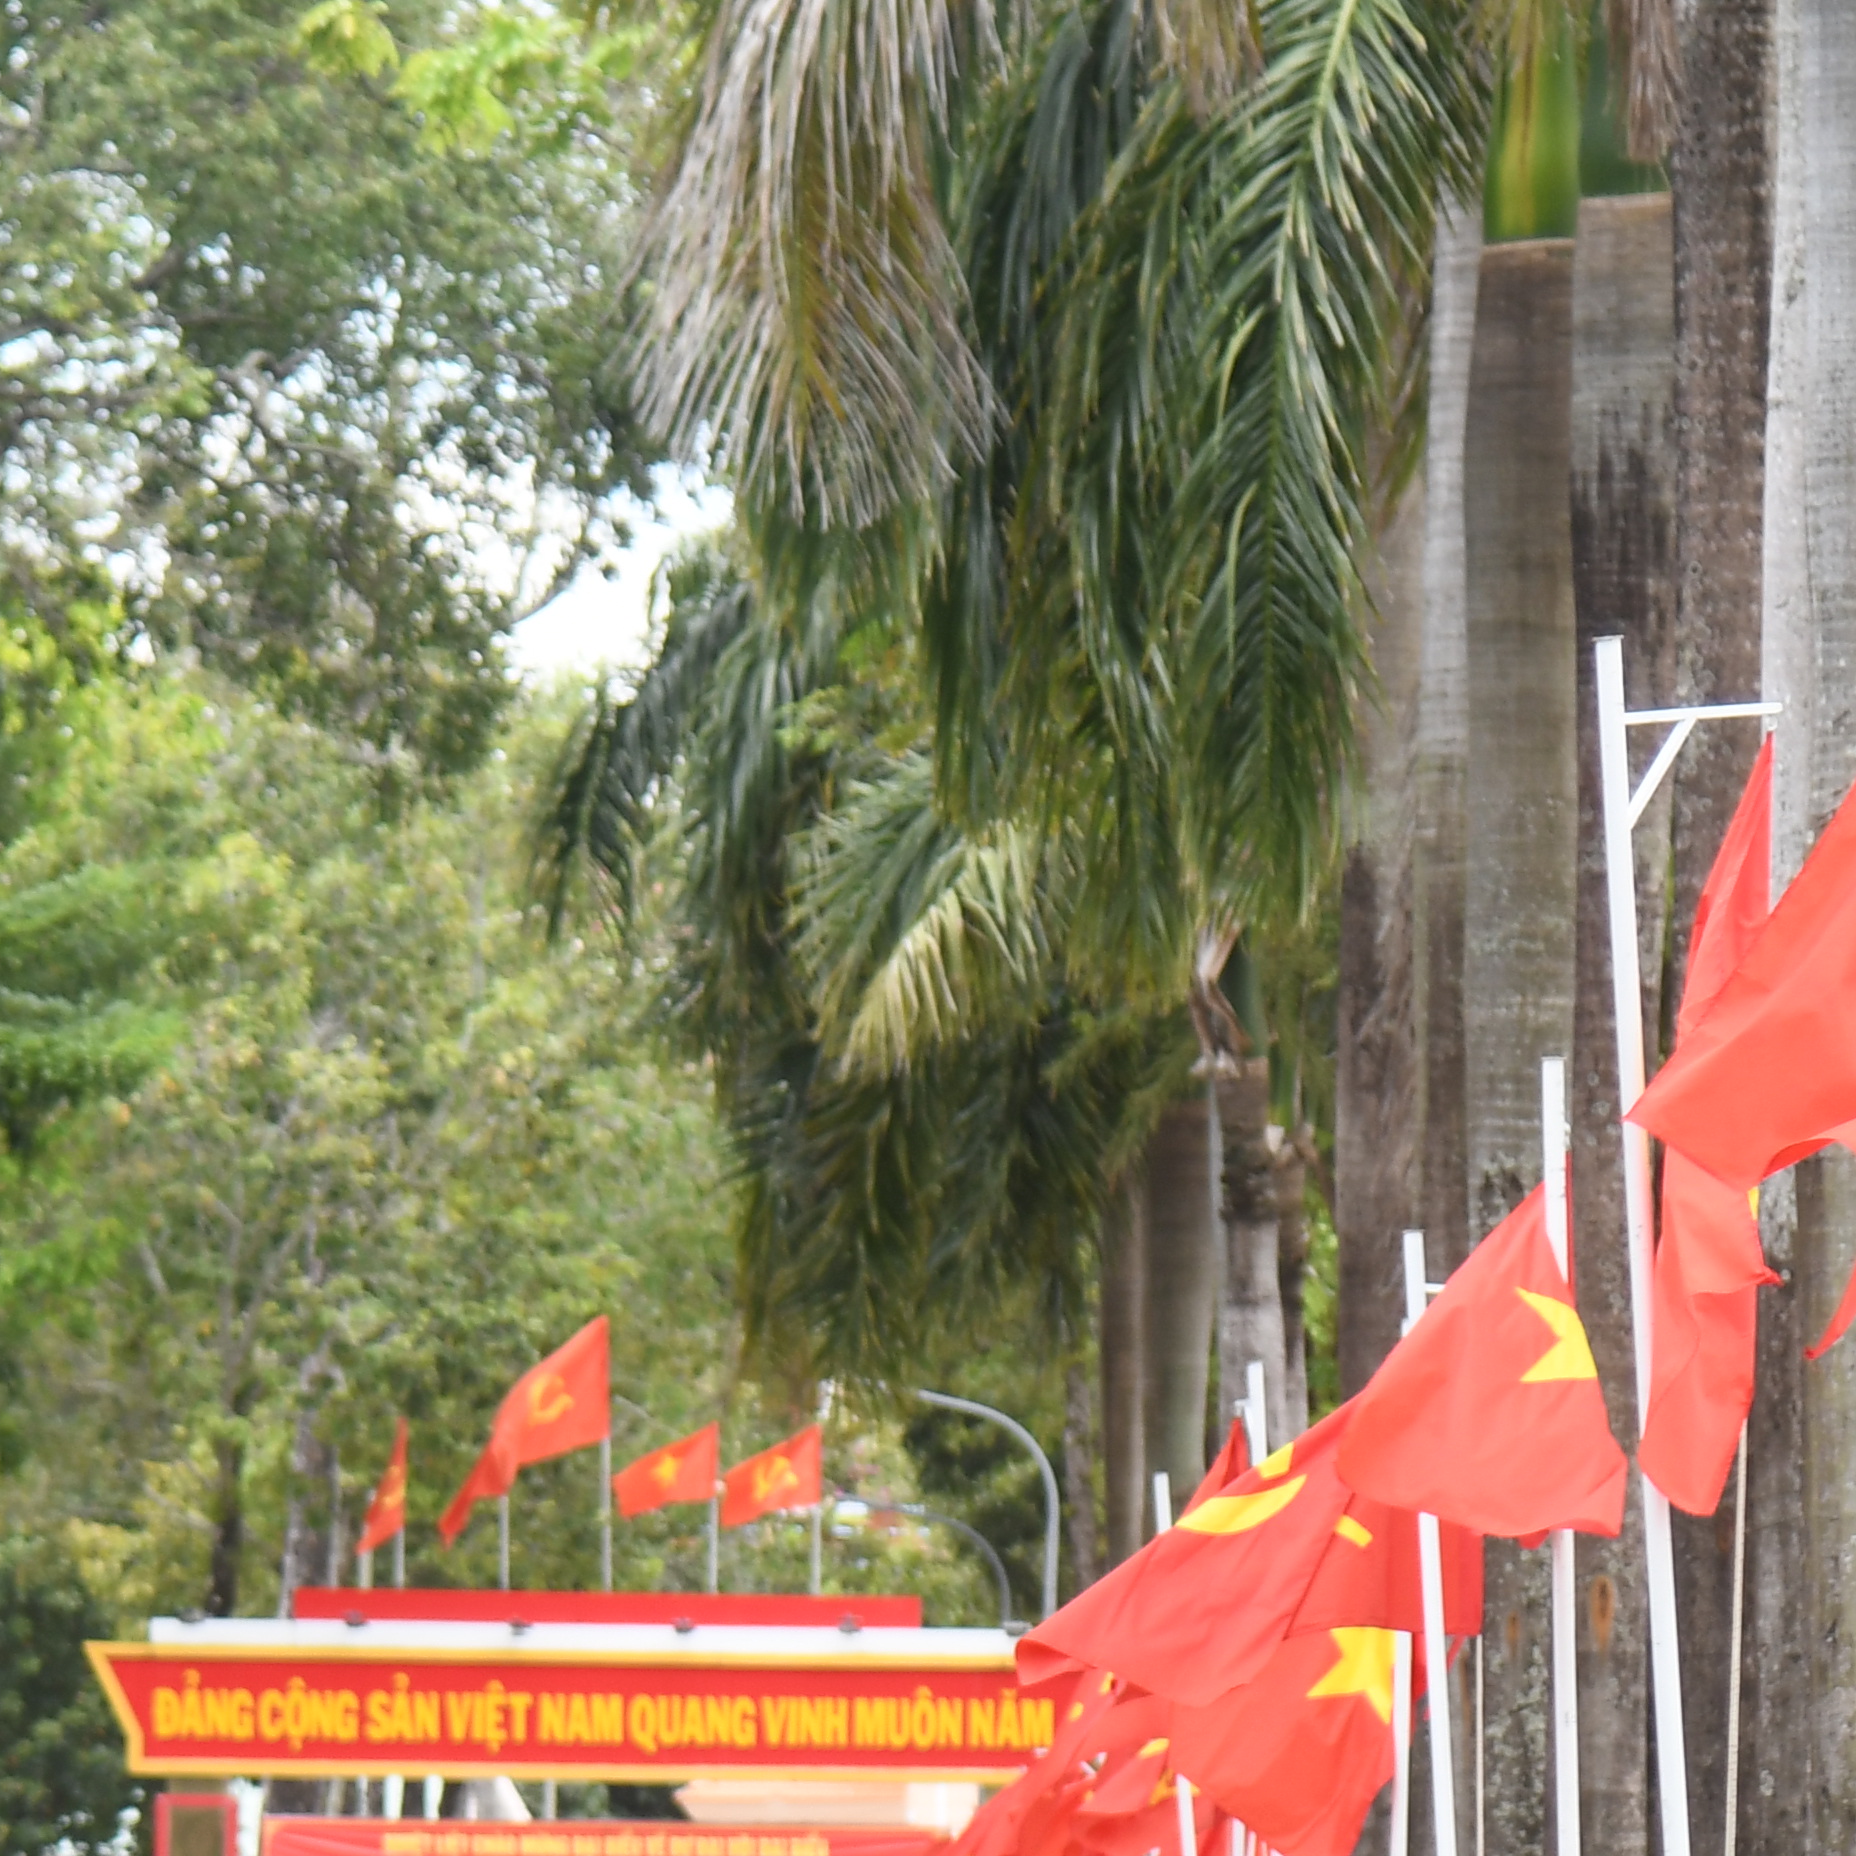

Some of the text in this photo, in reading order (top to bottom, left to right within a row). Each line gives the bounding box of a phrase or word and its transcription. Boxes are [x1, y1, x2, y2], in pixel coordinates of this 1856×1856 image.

[152, 1668, 1055, 1755] ĐẢNG CỘNG SẢN VIỆT NAM QUANG VINH MUÔN NĂM
